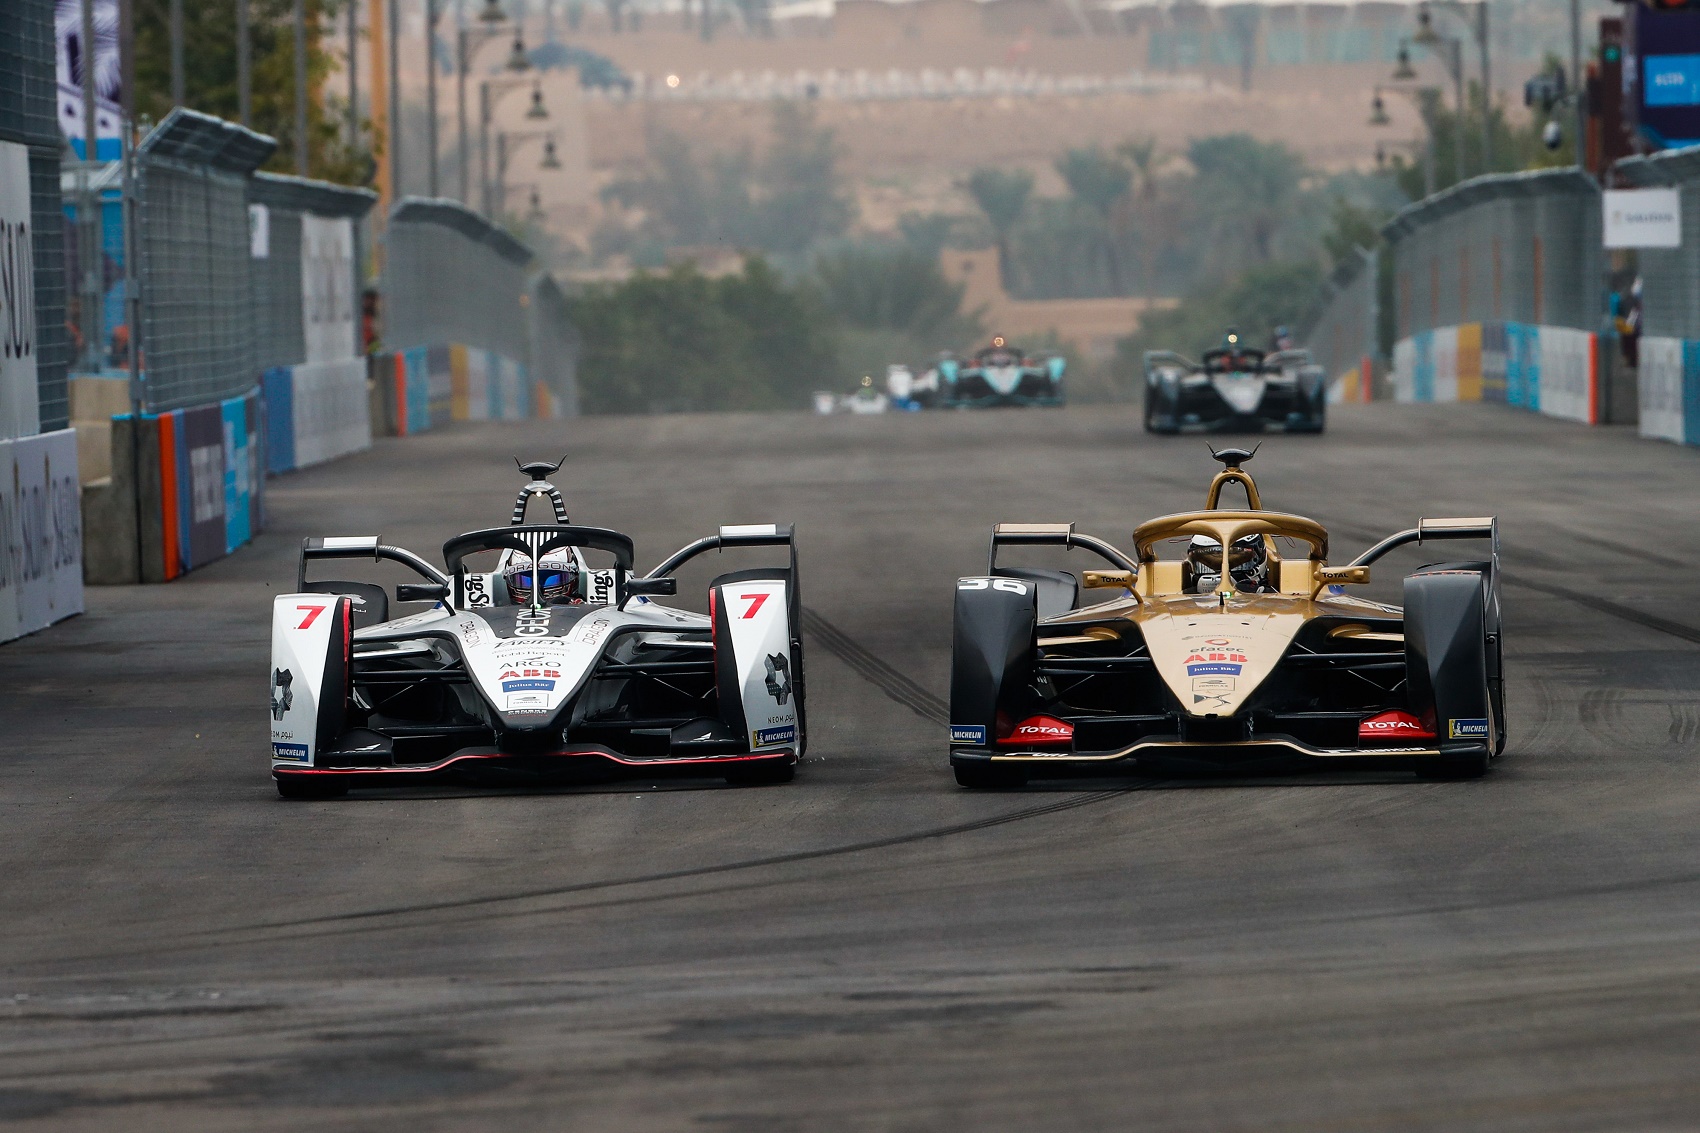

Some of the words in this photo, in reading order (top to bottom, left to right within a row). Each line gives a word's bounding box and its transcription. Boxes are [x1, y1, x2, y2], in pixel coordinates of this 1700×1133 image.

[740, 593, 771, 619] 7
[296, 605, 326, 629] 7
[1183, 653, 1248, 664] ABB
[499, 660, 561, 669] ARGO
[498, 669, 561, 680] ABB
[768, 715, 784, 724] NEOM
[1019, 725, 1069, 734] TOTAL
[1364, 721, 1420, 729] TOTAL
[765, 731, 793, 742] MICHELIN
[954, 731, 982, 739] MICHELIN
[278, 748, 306, 757] MICHELIN
